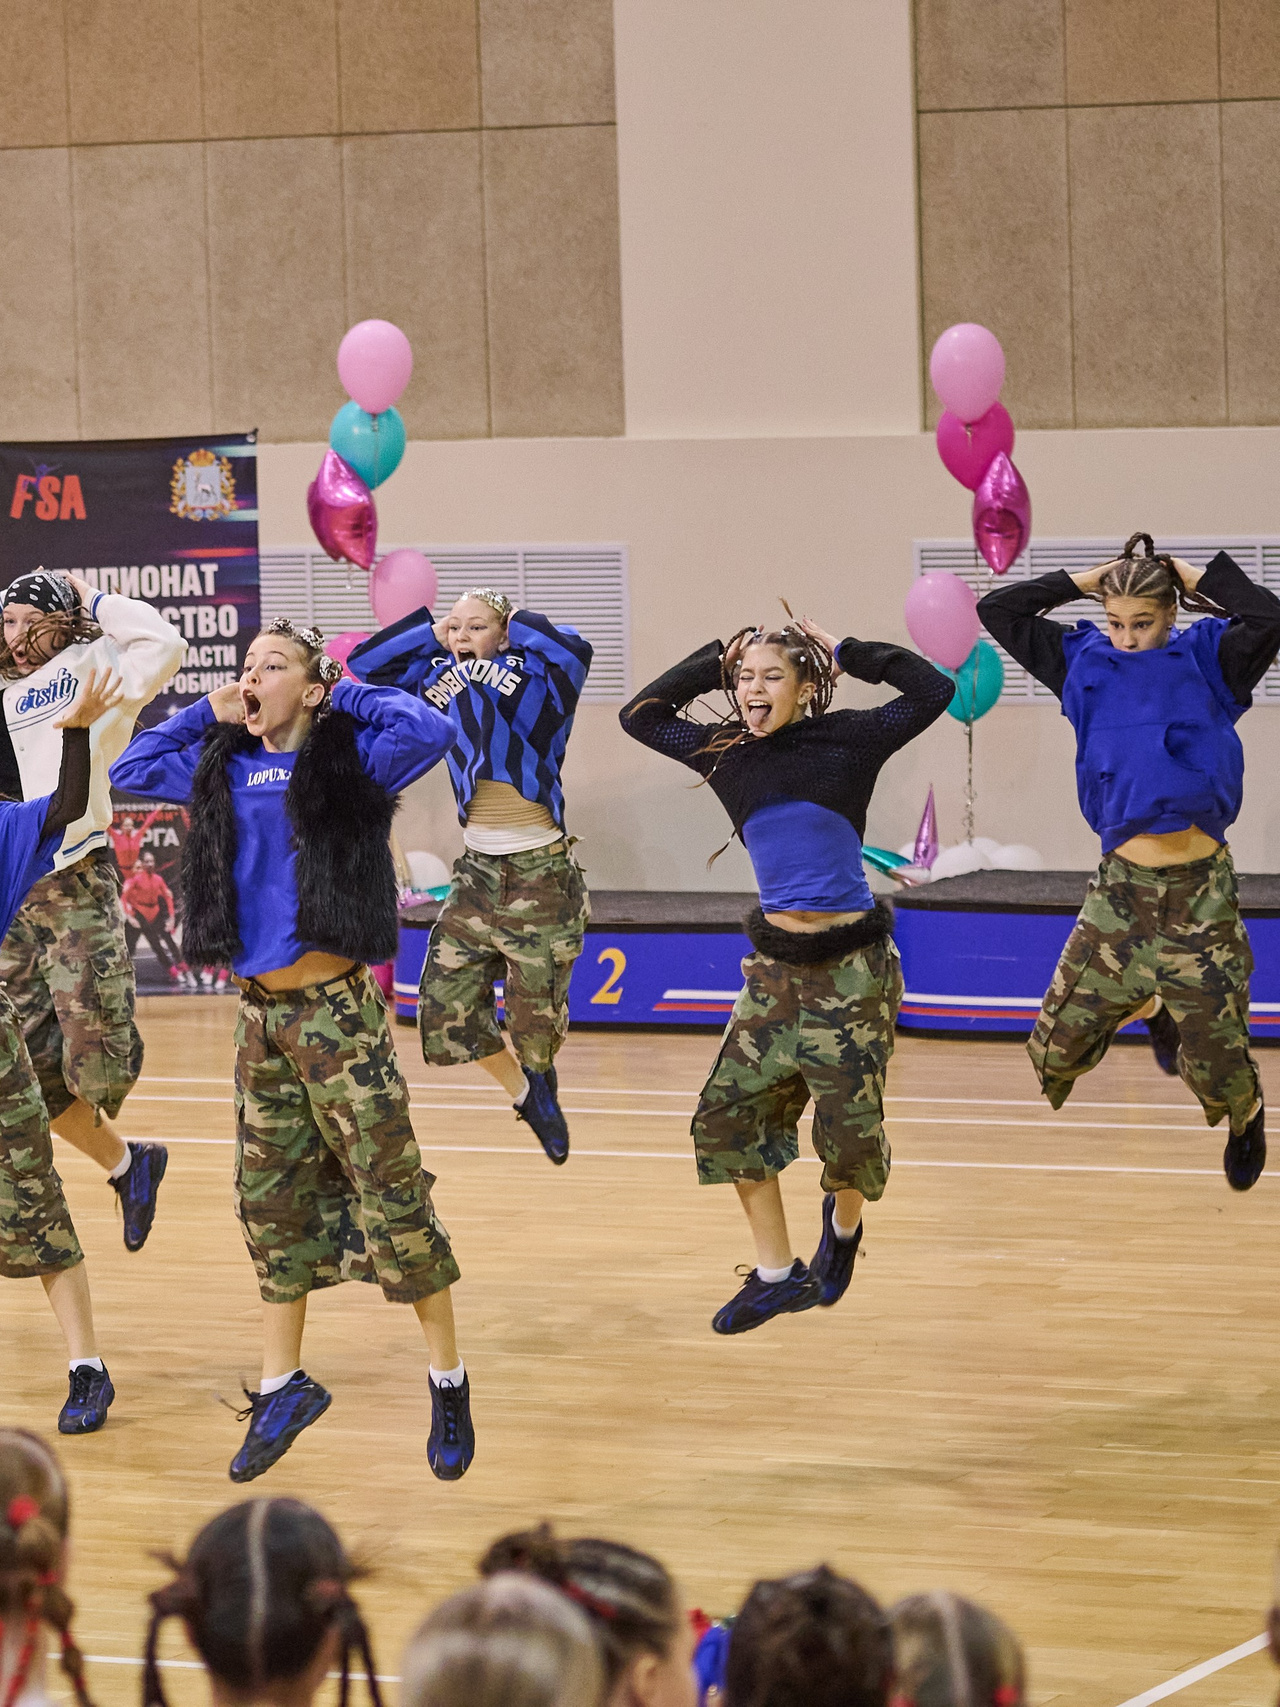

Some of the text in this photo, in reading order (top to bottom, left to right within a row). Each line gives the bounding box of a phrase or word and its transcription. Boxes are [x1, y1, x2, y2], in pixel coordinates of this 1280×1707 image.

[9, 474, 87, 521] FSA
[51, 563, 219, 600] МПИОНАТ
[160, 604, 239, 639] СТВО
[181, 644, 237, 668] АСТИ
[590, 947, 627, 1004] 2
